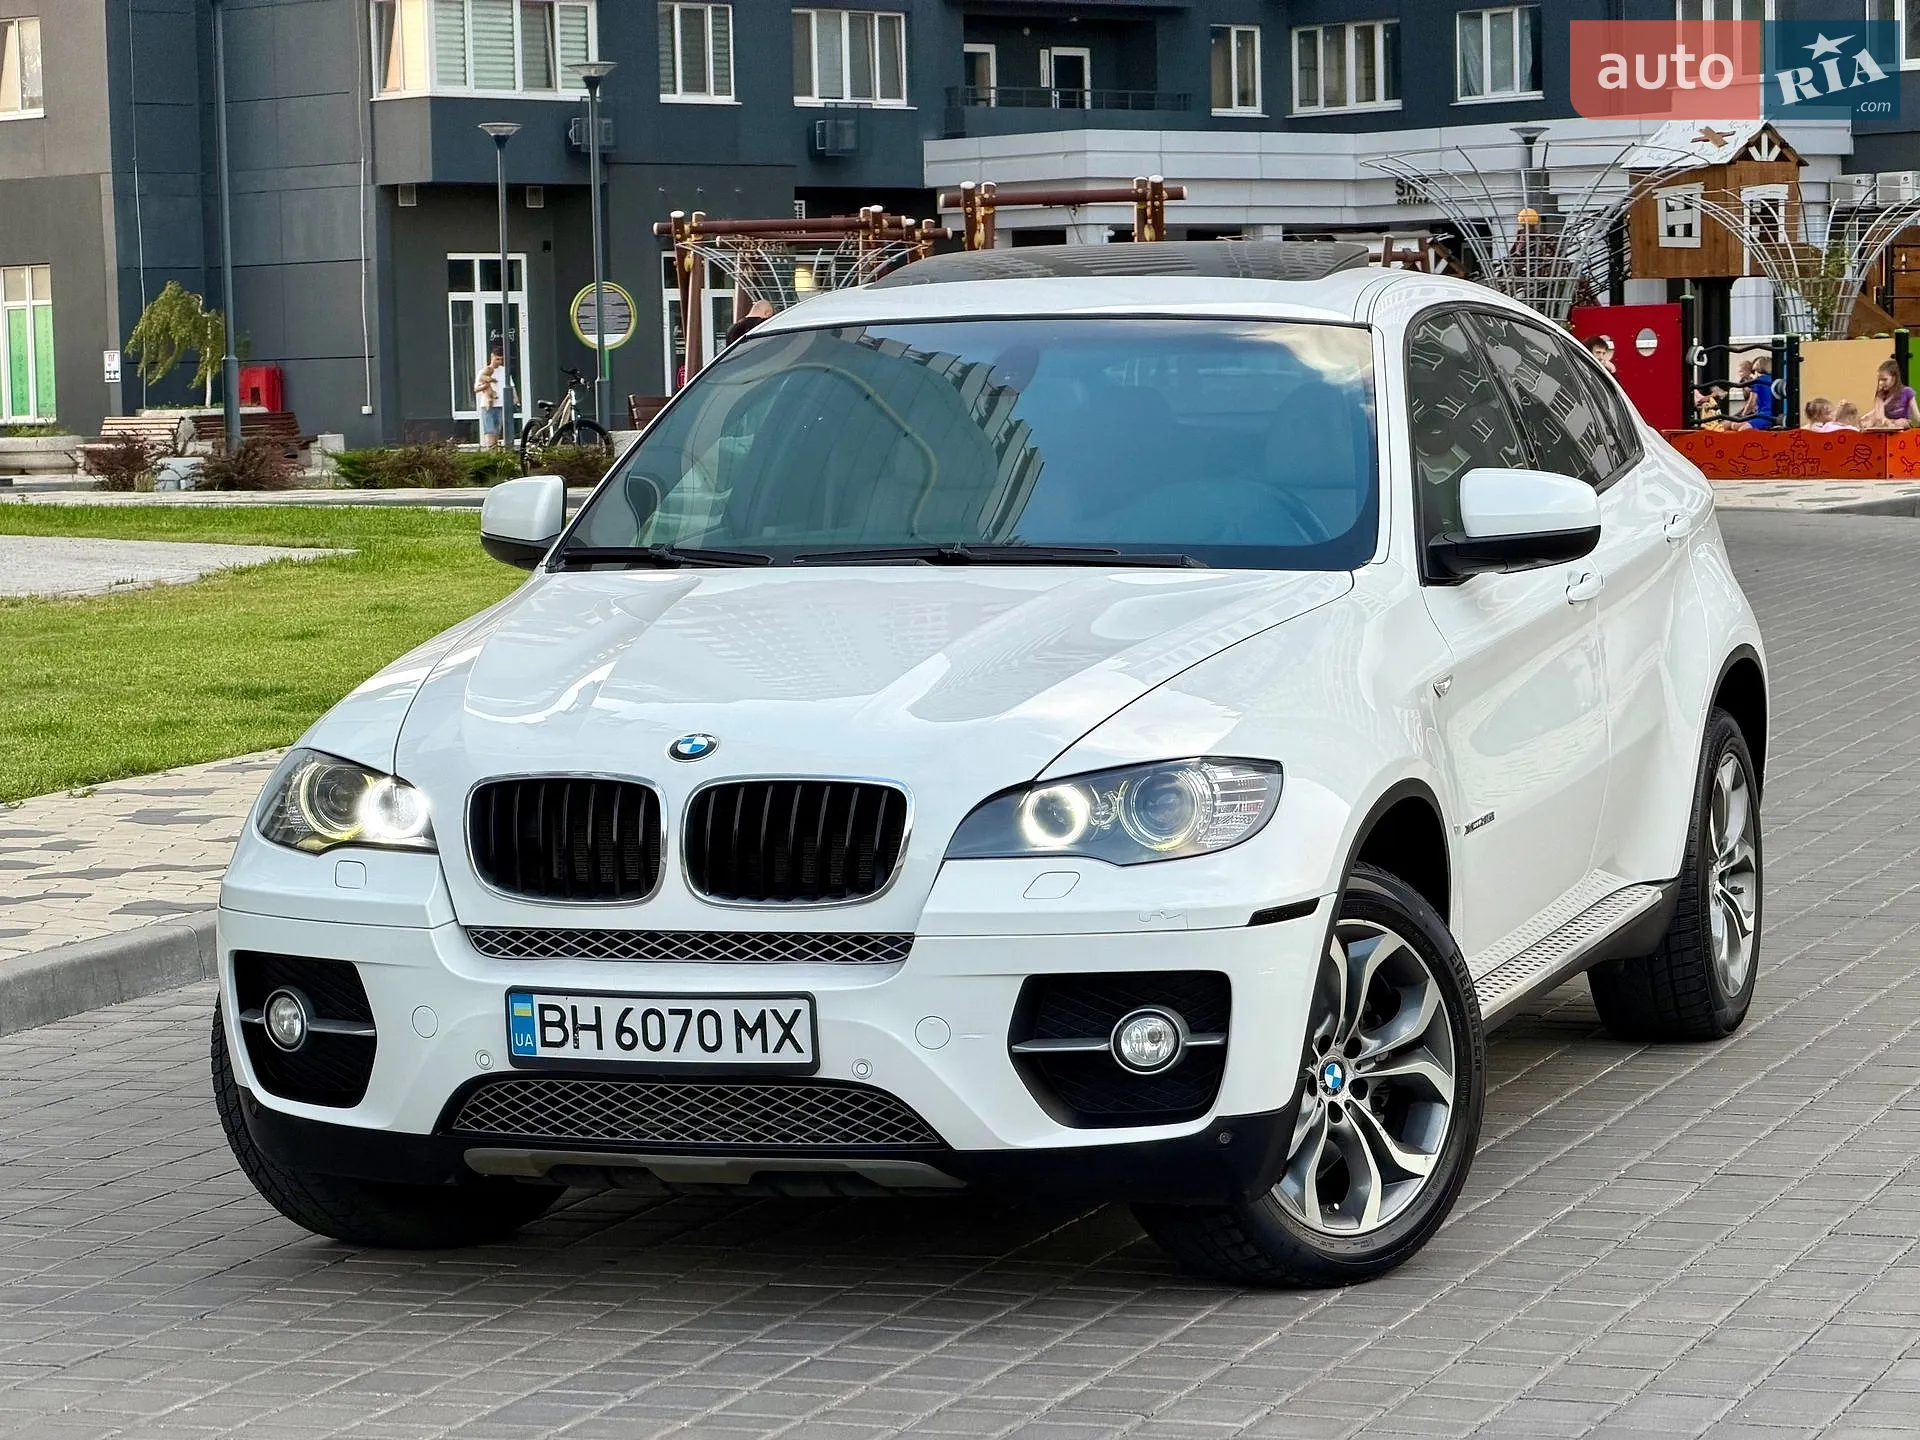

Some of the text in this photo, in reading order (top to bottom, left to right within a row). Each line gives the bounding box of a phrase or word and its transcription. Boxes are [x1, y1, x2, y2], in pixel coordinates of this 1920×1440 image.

[515, 1033, 534, 1047] UA
[538, 1003, 805, 1054] BH 6070 MX
